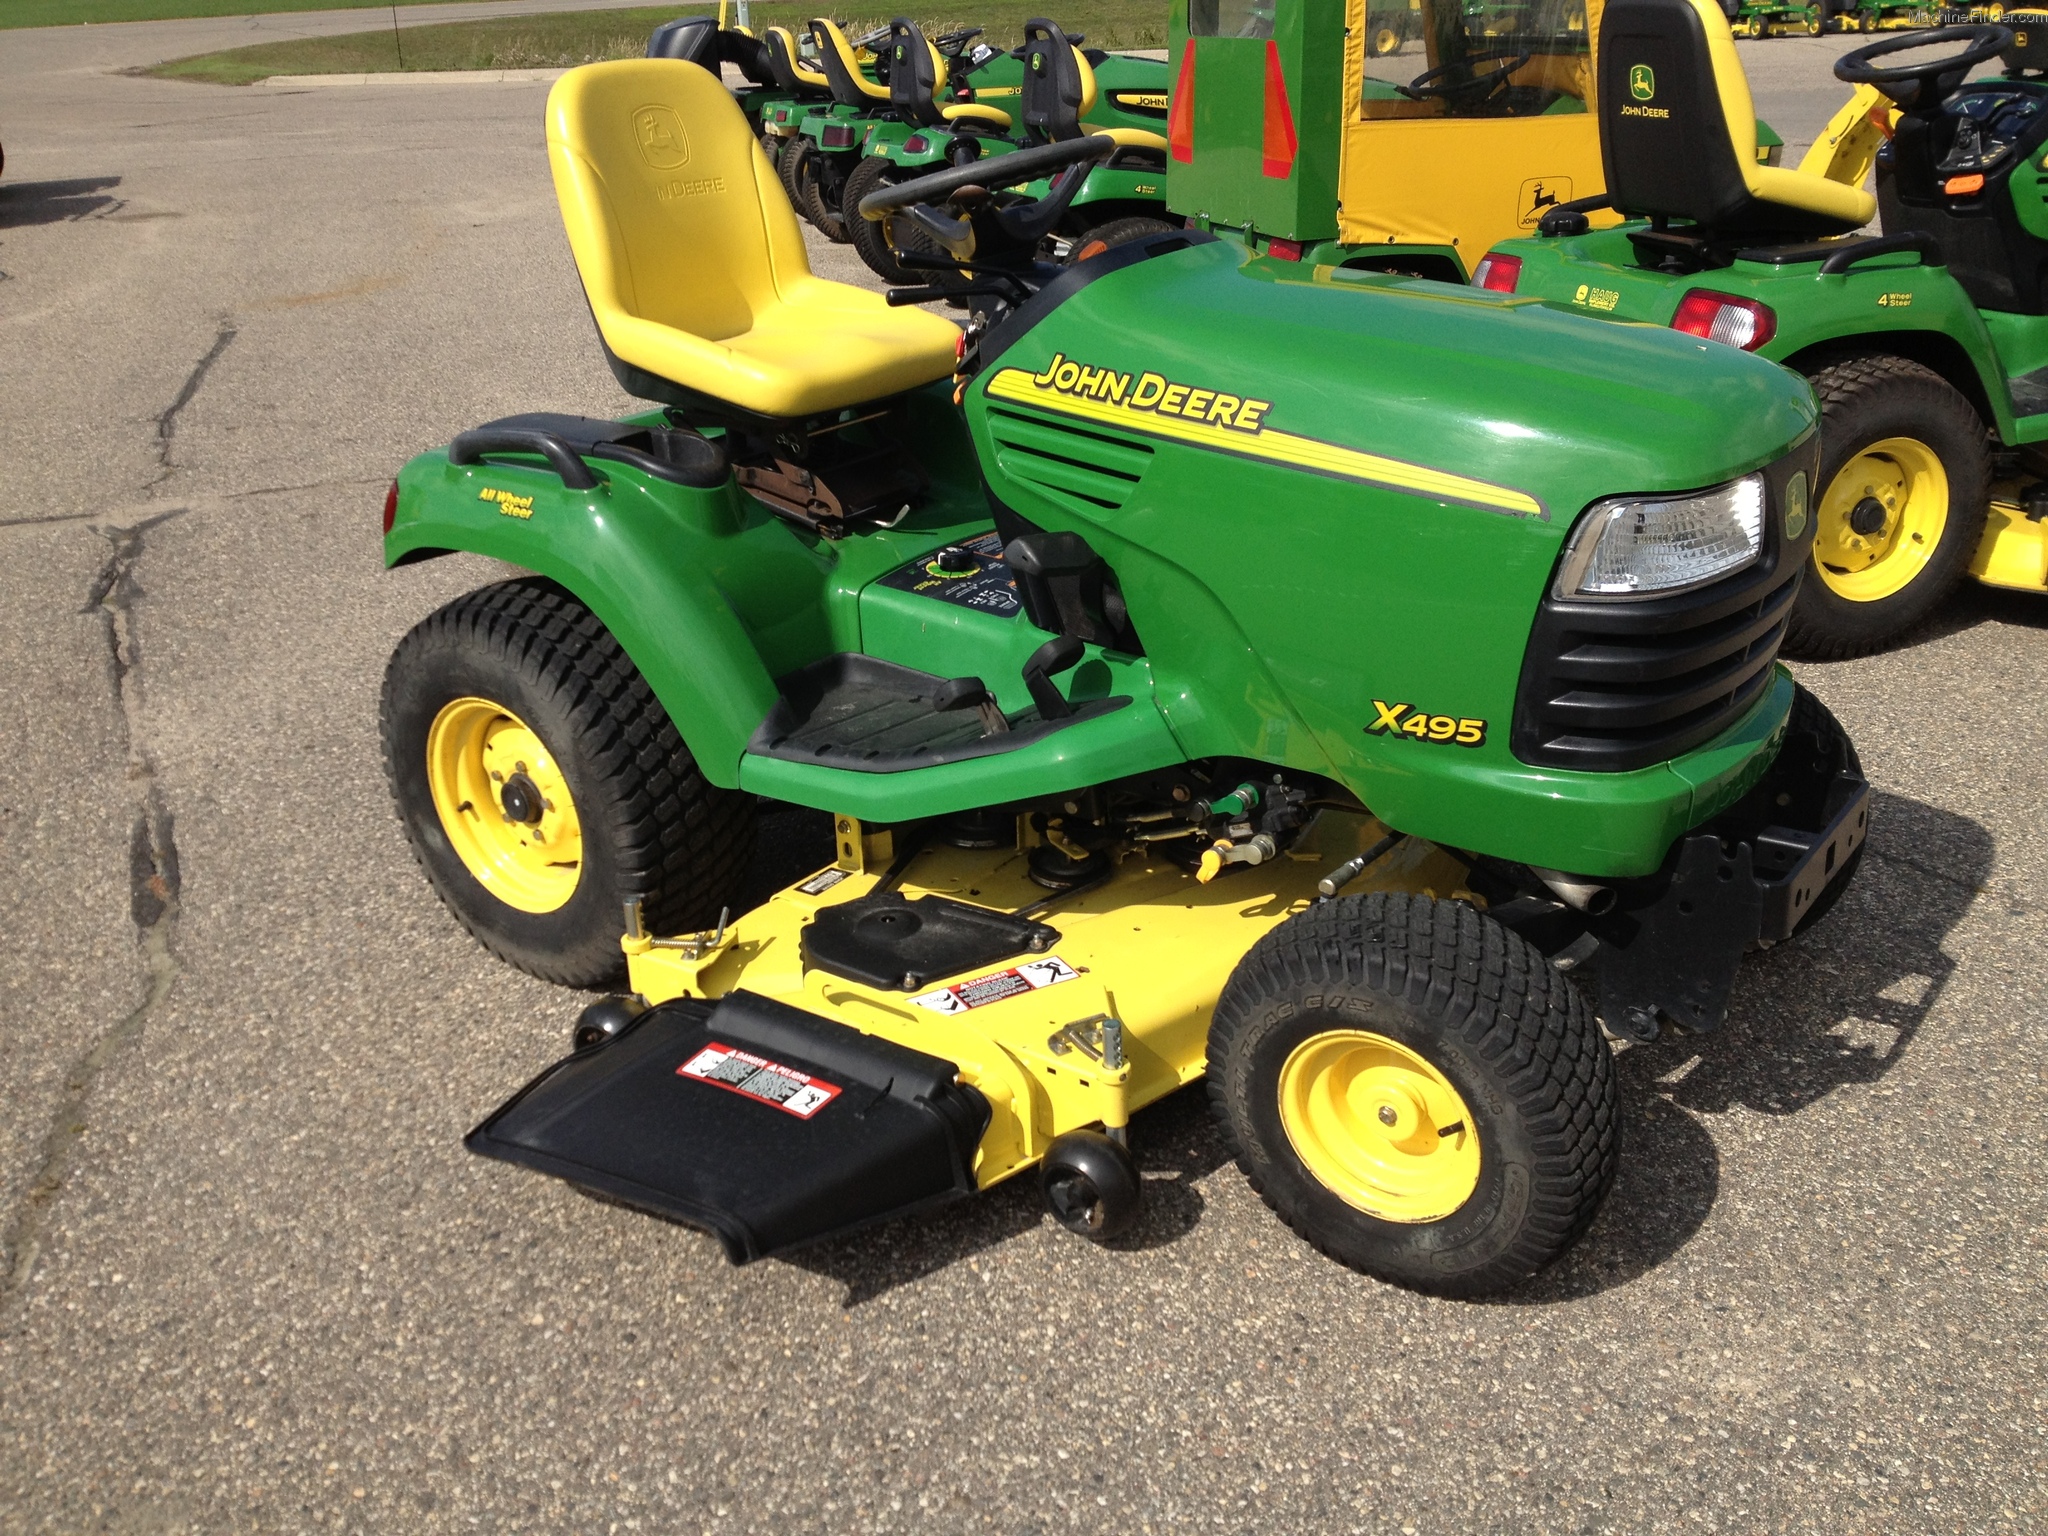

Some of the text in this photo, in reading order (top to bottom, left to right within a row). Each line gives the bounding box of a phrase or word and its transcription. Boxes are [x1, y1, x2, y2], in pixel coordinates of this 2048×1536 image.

[1136, 96, 1165, 106] JOHN
[1621, 104, 1670, 118] JOHN DEERE
[1877, 292, 1912, 307] 4 Wheel
[1889, 299, 1911, 307] Steer
[1034, 352, 1273, 434] JOHN DEERE
[479, 487, 534, 509] All Wheel
[500, 502, 534, 520] Steer
[1364, 699, 1487, 747] X495
[968, 971, 1009, 987] DANGER
[1241, 1001, 1294, 1060] TRAC
[735, 1051, 768, 1068] DANGER
[776, 1066, 811, 1084] PELIGRO
